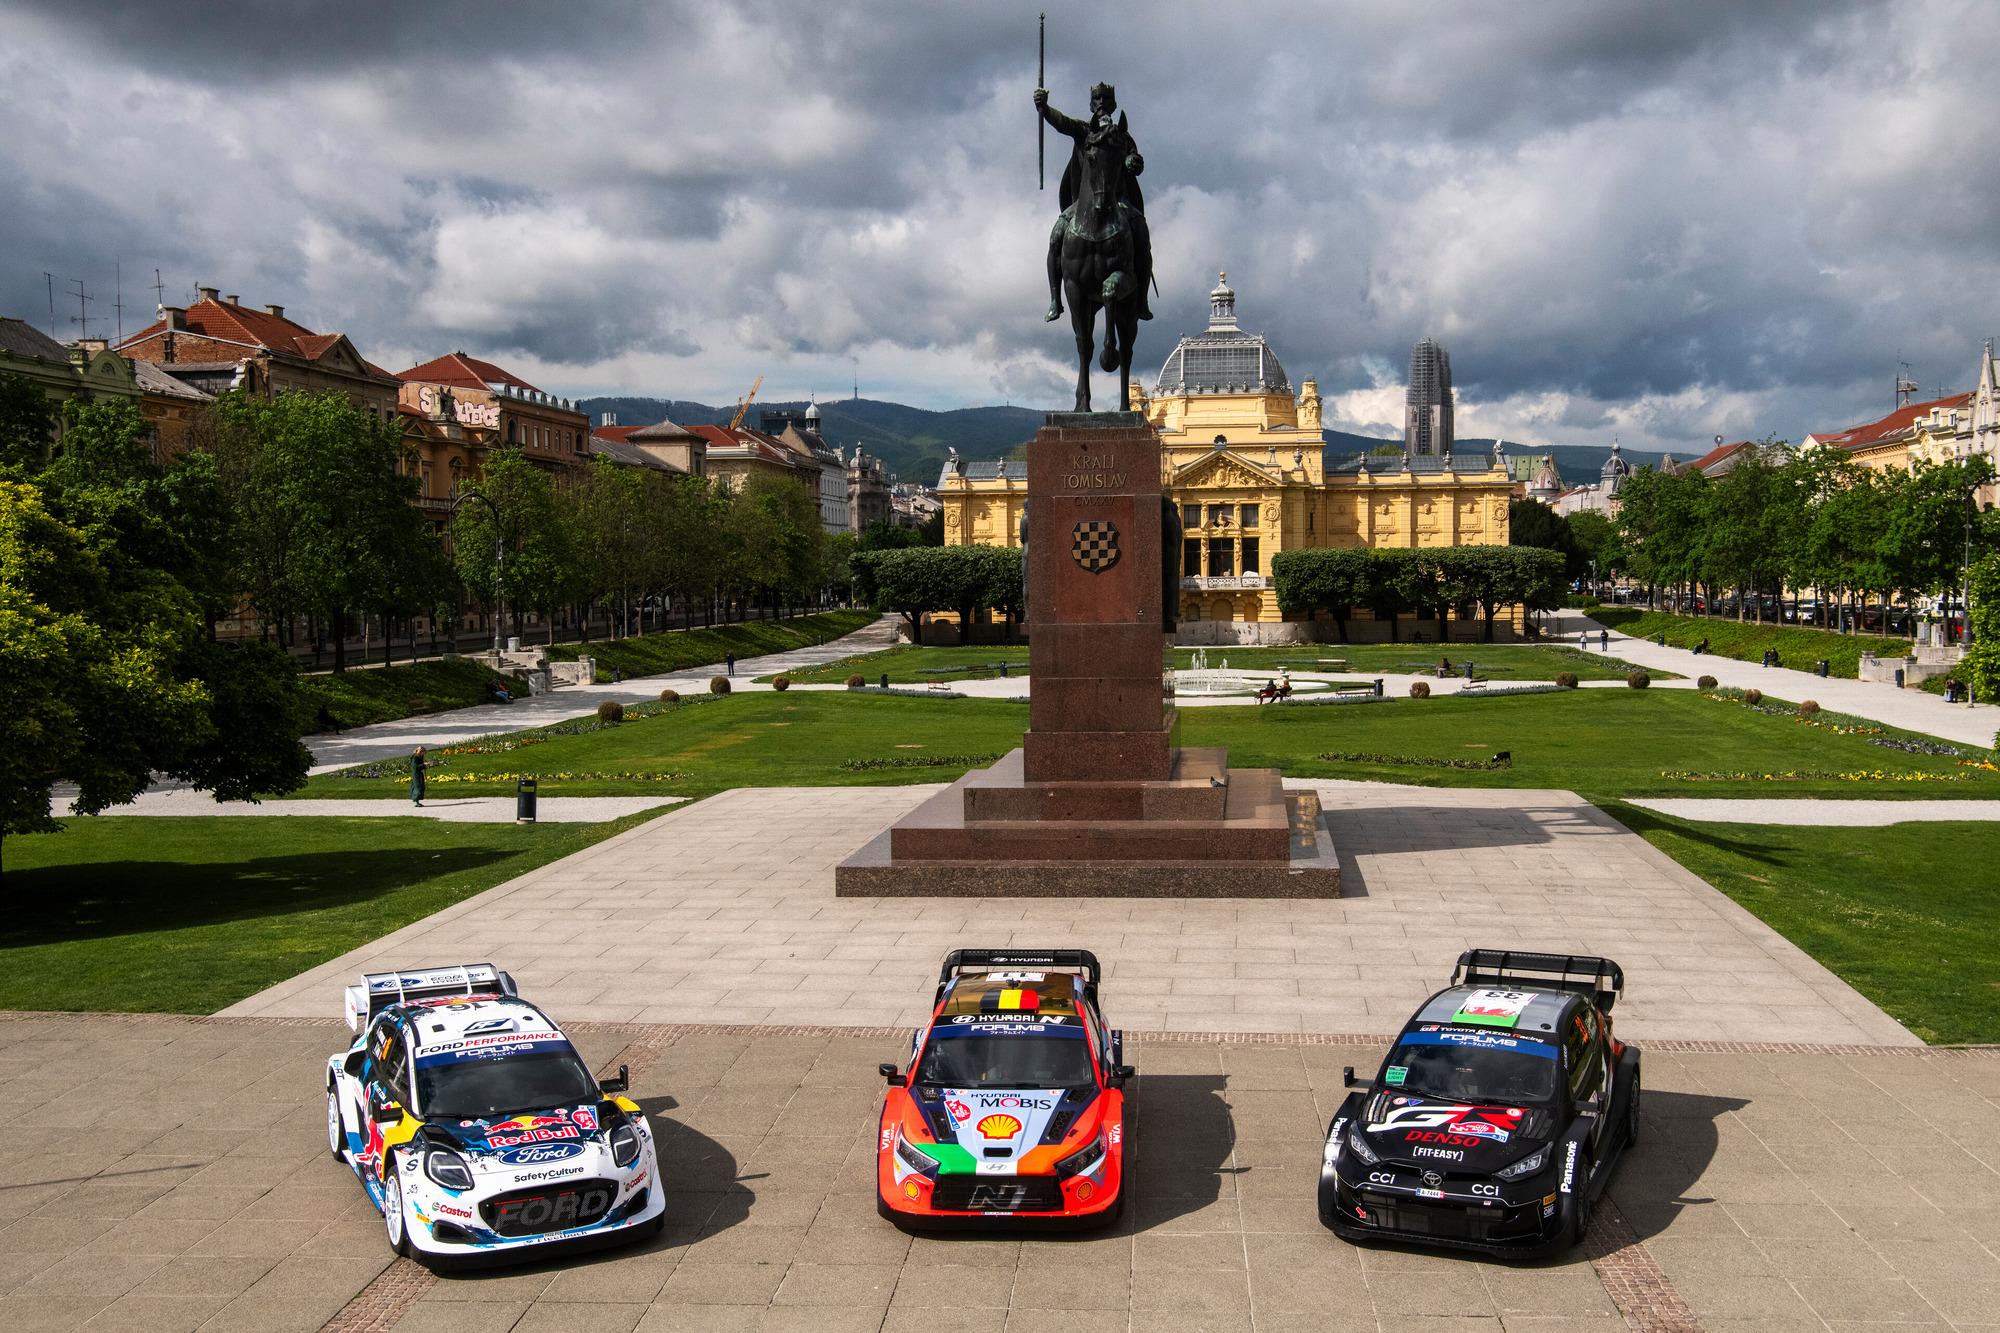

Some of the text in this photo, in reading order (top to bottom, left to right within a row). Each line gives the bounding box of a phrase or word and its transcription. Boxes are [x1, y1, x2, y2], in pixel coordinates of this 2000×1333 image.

[1073, 455, 1114, 470] KRALJ
[1061, 474, 1127, 489] TOMISLAV
[979, 1014, 1035, 1022] HYUNDAI
[420, 1033, 559, 1055] FORD PERFORMANCE
[1440, 1033, 1517, 1047] FORUM8
[1476, 1029, 1511, 1037] GAZOO
[1513, 1034, 1544, 1044] Racing
[455, 1043, 534, 1058] FORUM8
[980, 1098, 1052, 1110] MOBIS
[487, 1125, 581, 1149] Red Bull
[1405, 1131, 1481, 1147] DENSO
[1560, 1140, 1577, 1193] Panasonic
[514, 1166, 585, 1183] SafetyCulture
[440, 1205, 473, 1219] Castrol
[494, 1189, 609, 1230] FORD
